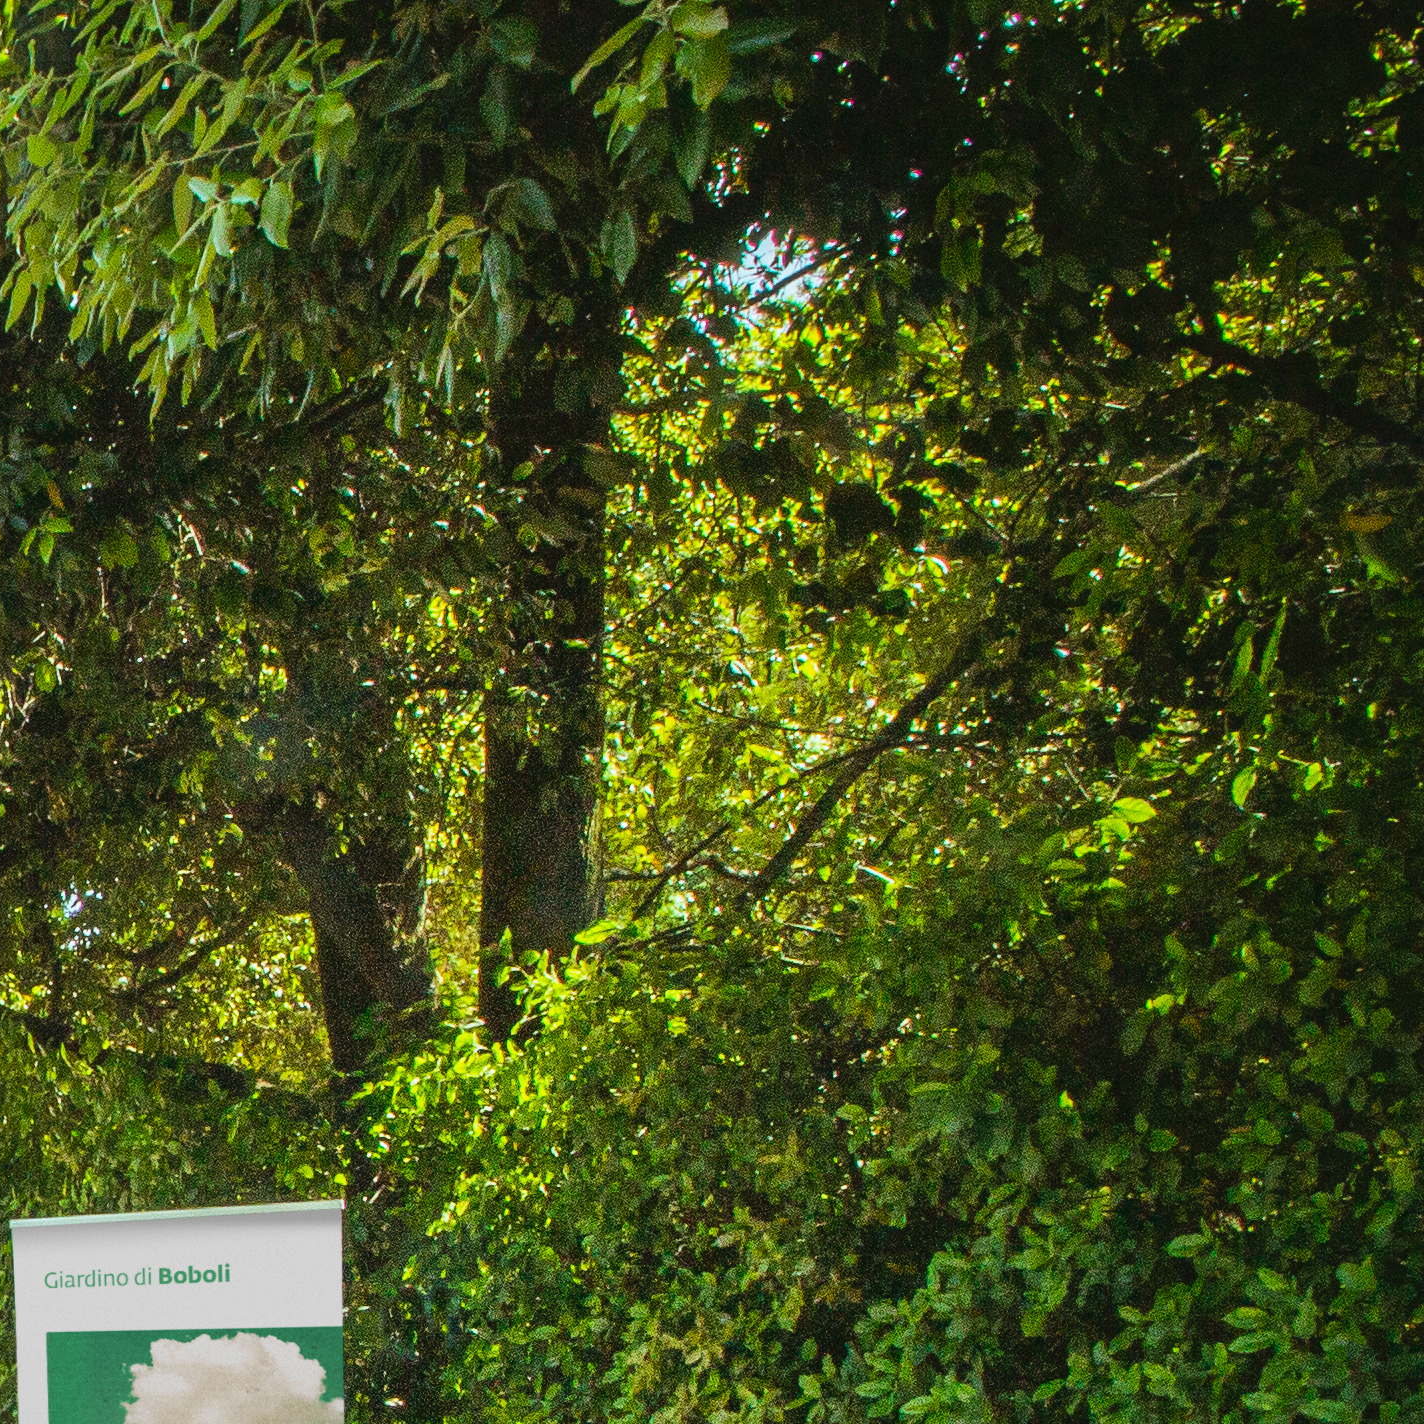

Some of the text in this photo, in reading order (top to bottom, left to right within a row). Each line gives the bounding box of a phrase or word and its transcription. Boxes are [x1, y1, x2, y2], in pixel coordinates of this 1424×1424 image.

[45, 1263, 230, 1288] Giardino di Boboli
